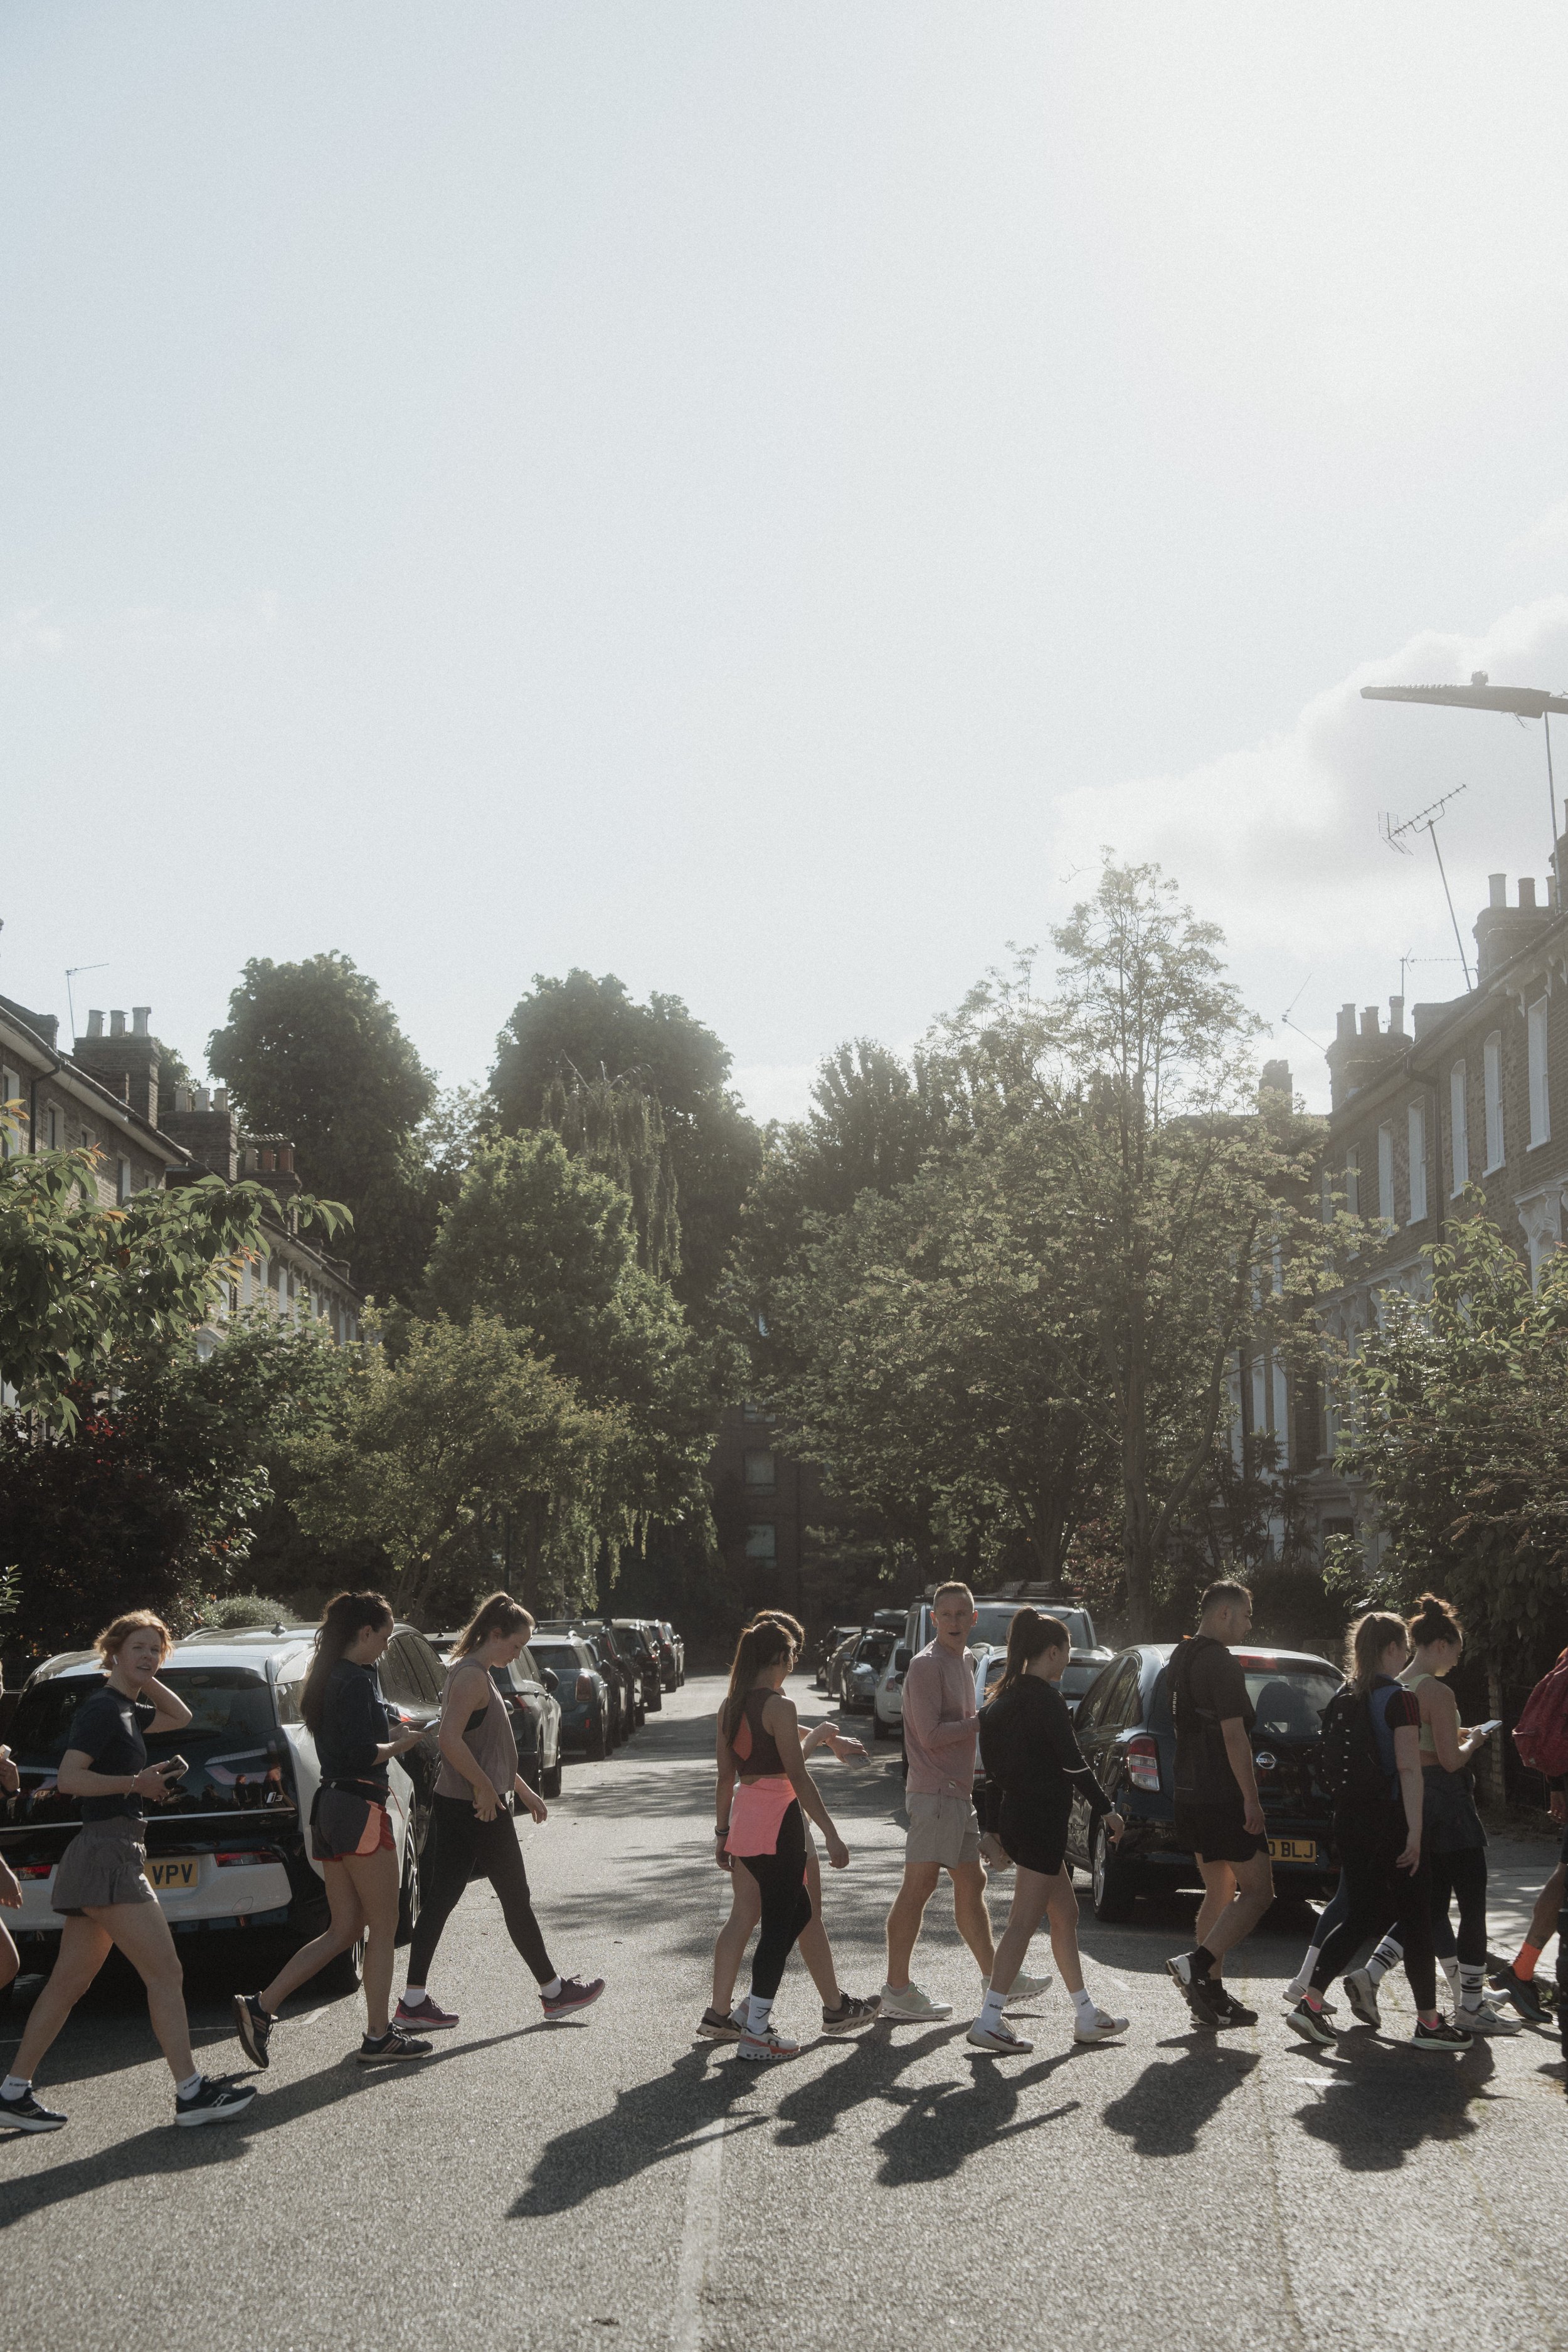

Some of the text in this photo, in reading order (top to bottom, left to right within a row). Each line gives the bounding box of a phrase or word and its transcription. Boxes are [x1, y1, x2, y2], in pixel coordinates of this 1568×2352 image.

[267, 1792, 283, 1803] i3
[1281, 1841, 1313, 1858] BLJ
[152, 1863, 194, 1885] VPV
